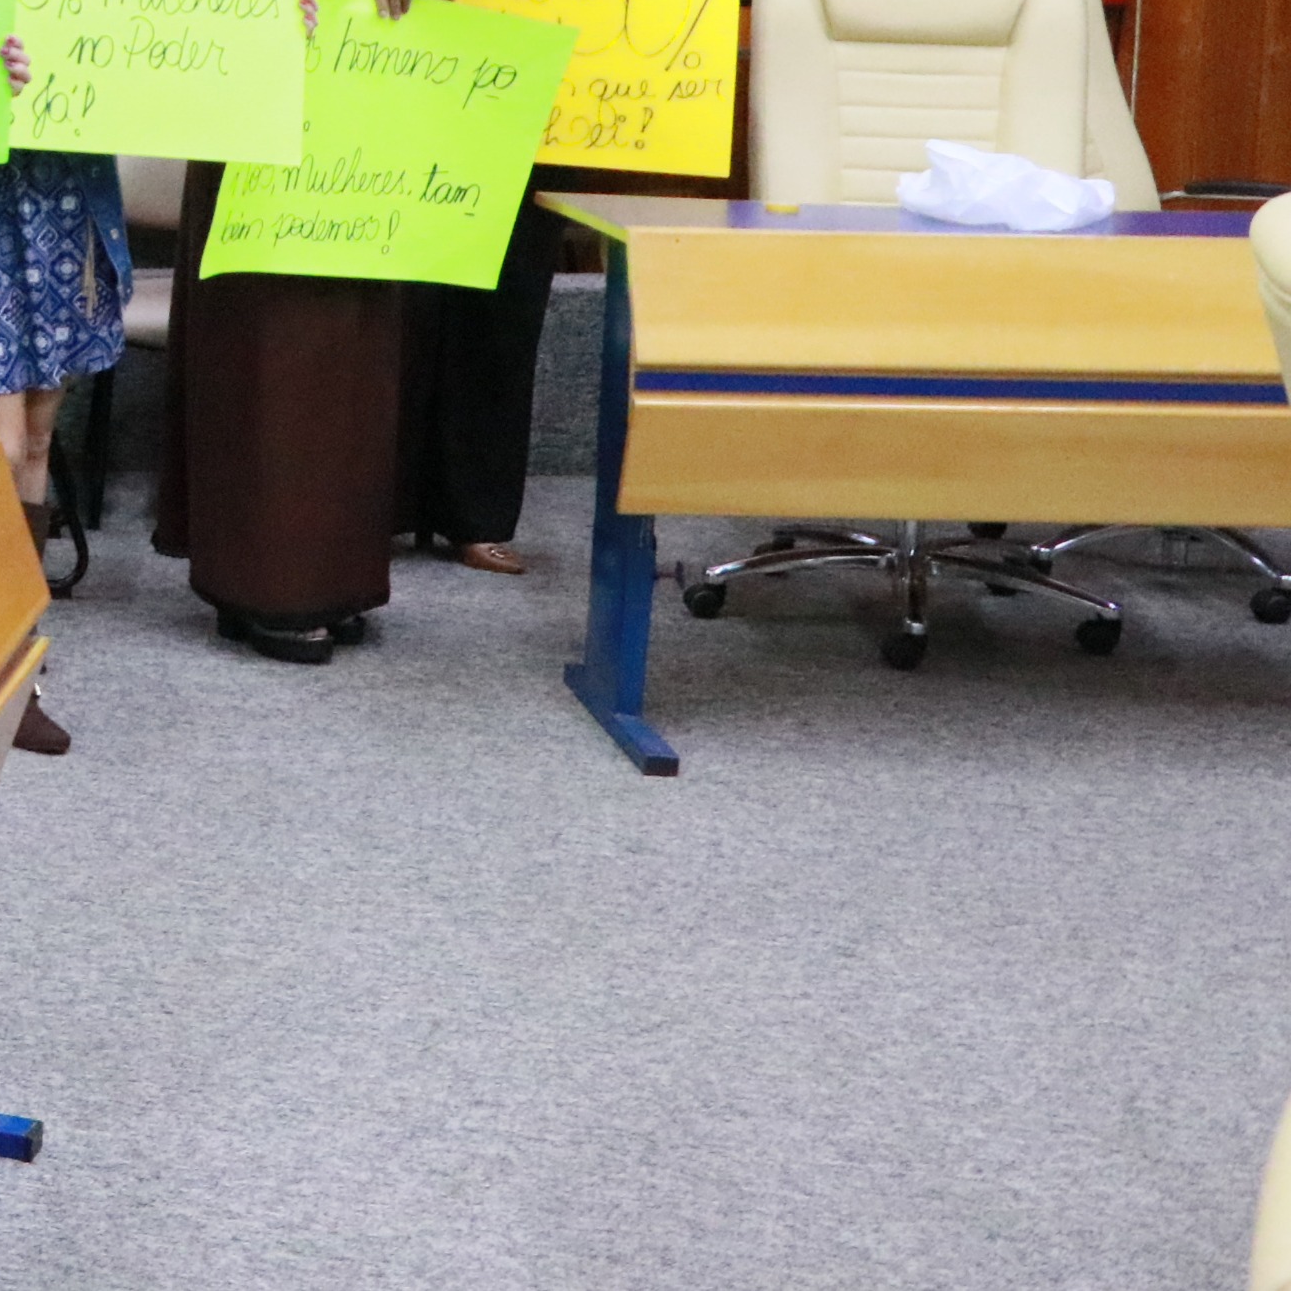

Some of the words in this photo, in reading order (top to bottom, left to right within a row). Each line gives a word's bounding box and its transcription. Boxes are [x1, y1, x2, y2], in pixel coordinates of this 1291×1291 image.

[67, 33, 115, 68] no
[122, 16, 229, 77] Poder
[333, 16, 460, 85] homens
[588, 78, 657, 128] que
[667, 78, 727, 102] ser
